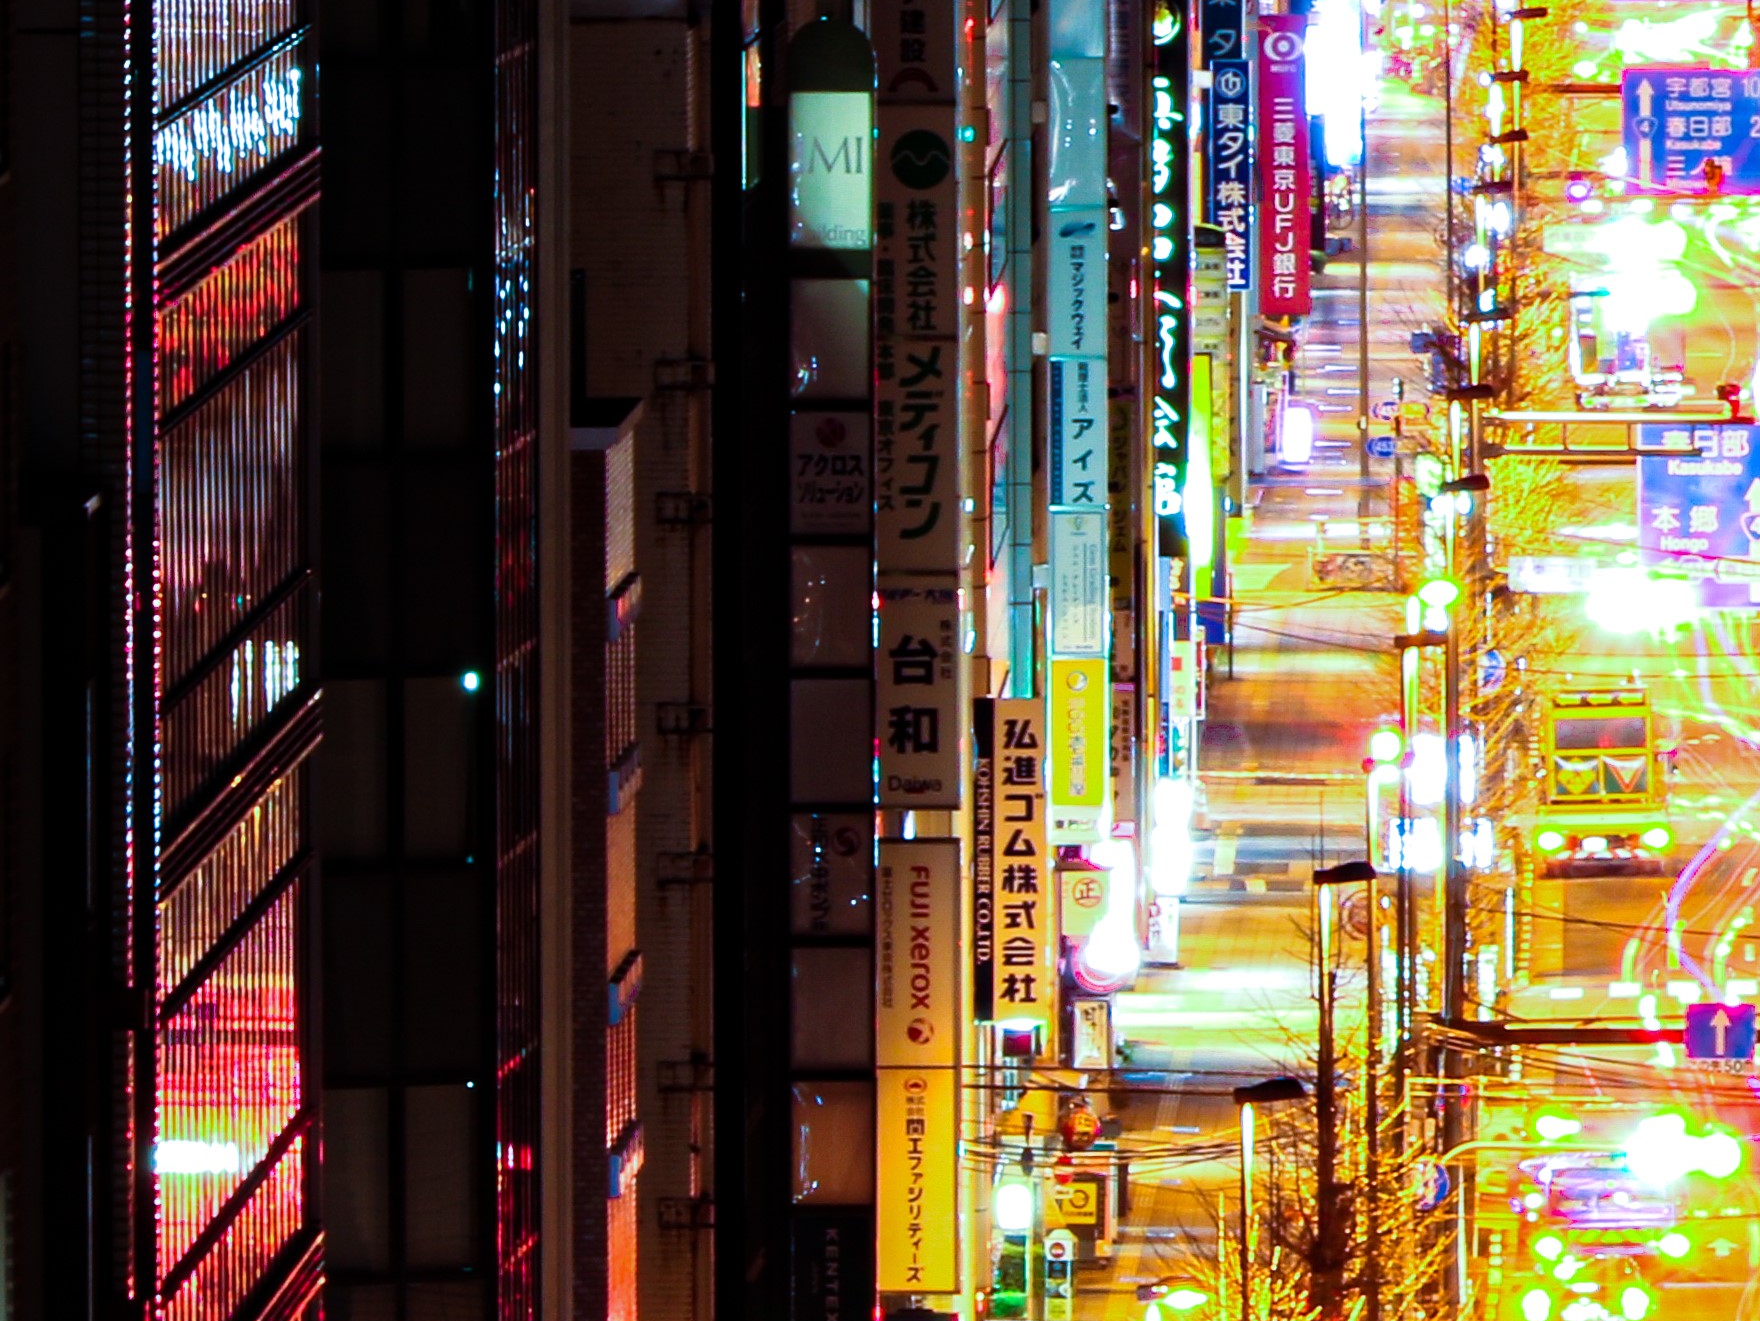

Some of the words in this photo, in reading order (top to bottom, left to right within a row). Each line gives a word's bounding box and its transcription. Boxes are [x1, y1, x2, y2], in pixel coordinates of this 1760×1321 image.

[1665, 77, 1733, 98] 宇都宮
[1665, 100, 1733, 112] Utsunomiya
[1666, 116, 1733, 138] 春日部
[1666, 139, 1723, 152] Kasukabe
[1216, 104, 1247, 286] 東タイ株式会社
[1272, 97, 1297, 299] 三菱東京UFJ銀行
[906, 198, 937, 331] 株式会社
[797, 453, 864, 477] アクロス
[901, 346, 942, 539] メディコン
[1071, 418, 1095, 503] アイズ
[1661, 429, 1750, 458] 春日部
[1667, 459, 1744, 476] Kasukabe
[798, 482, 865, 506] ソリューション
[1651, 505, 1719, 533] 本郷
[1659, 535, 1709, 554] Hongo
[939, 619, 953, 681] 株式会社
[888, 633, 939, 755] 台和
[887, 773, 943, 793] Daiwa
[977, 757, 992, 830] KOHSHIN
[977, 835, 992, 894] RUBBER
[1001, 718, 1044, 1004] 弘進ゴム株式会社
[909, 866, 930, 919] FUJI
[909, 926, 930, 1010] xerox
